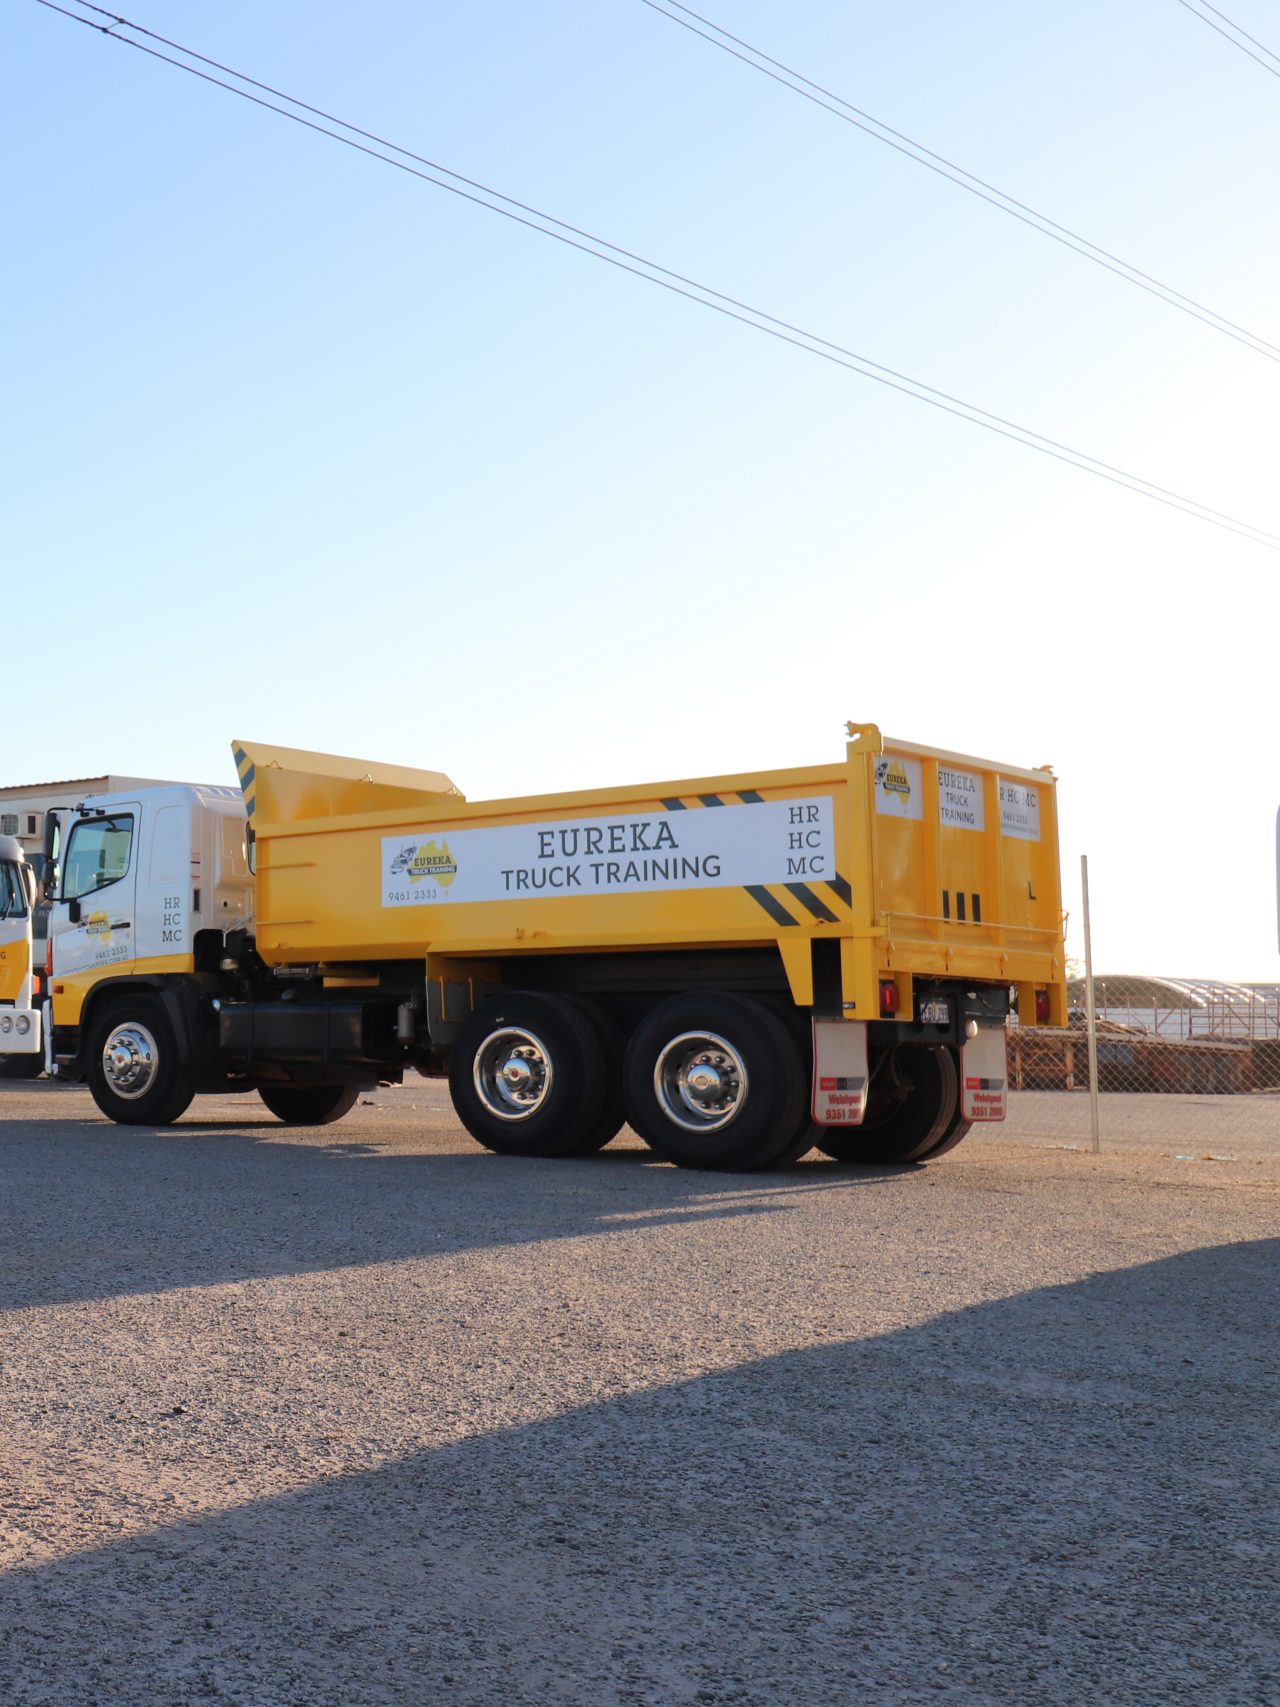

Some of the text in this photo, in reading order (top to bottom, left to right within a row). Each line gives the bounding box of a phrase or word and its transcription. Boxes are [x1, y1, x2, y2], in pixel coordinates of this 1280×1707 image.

[938, 771, 975, 792] EUREKA
[945, 792, 968, 807] TRUCK
[788, 805, 819, 824] HR
[941, 807, 975, 824] TRAINING
[537, 821, 679, 859] EUREKA
[787, 830, 821, 850] HC
[414, 855, 452, 867] EUREKA
[786, 855, 825, 875] MC
[501, 855, 721, 891] TRUCK TRAINING
[388, 889, 437, 901] 9461 2333
[164, 897, 180, 909] HR
[163, 913, 181, 926] HC
[162, 929, 183, 942] MC
[826, 1109, 845, 1120] 9351
[971, 1106, 987, 1117] 9351
